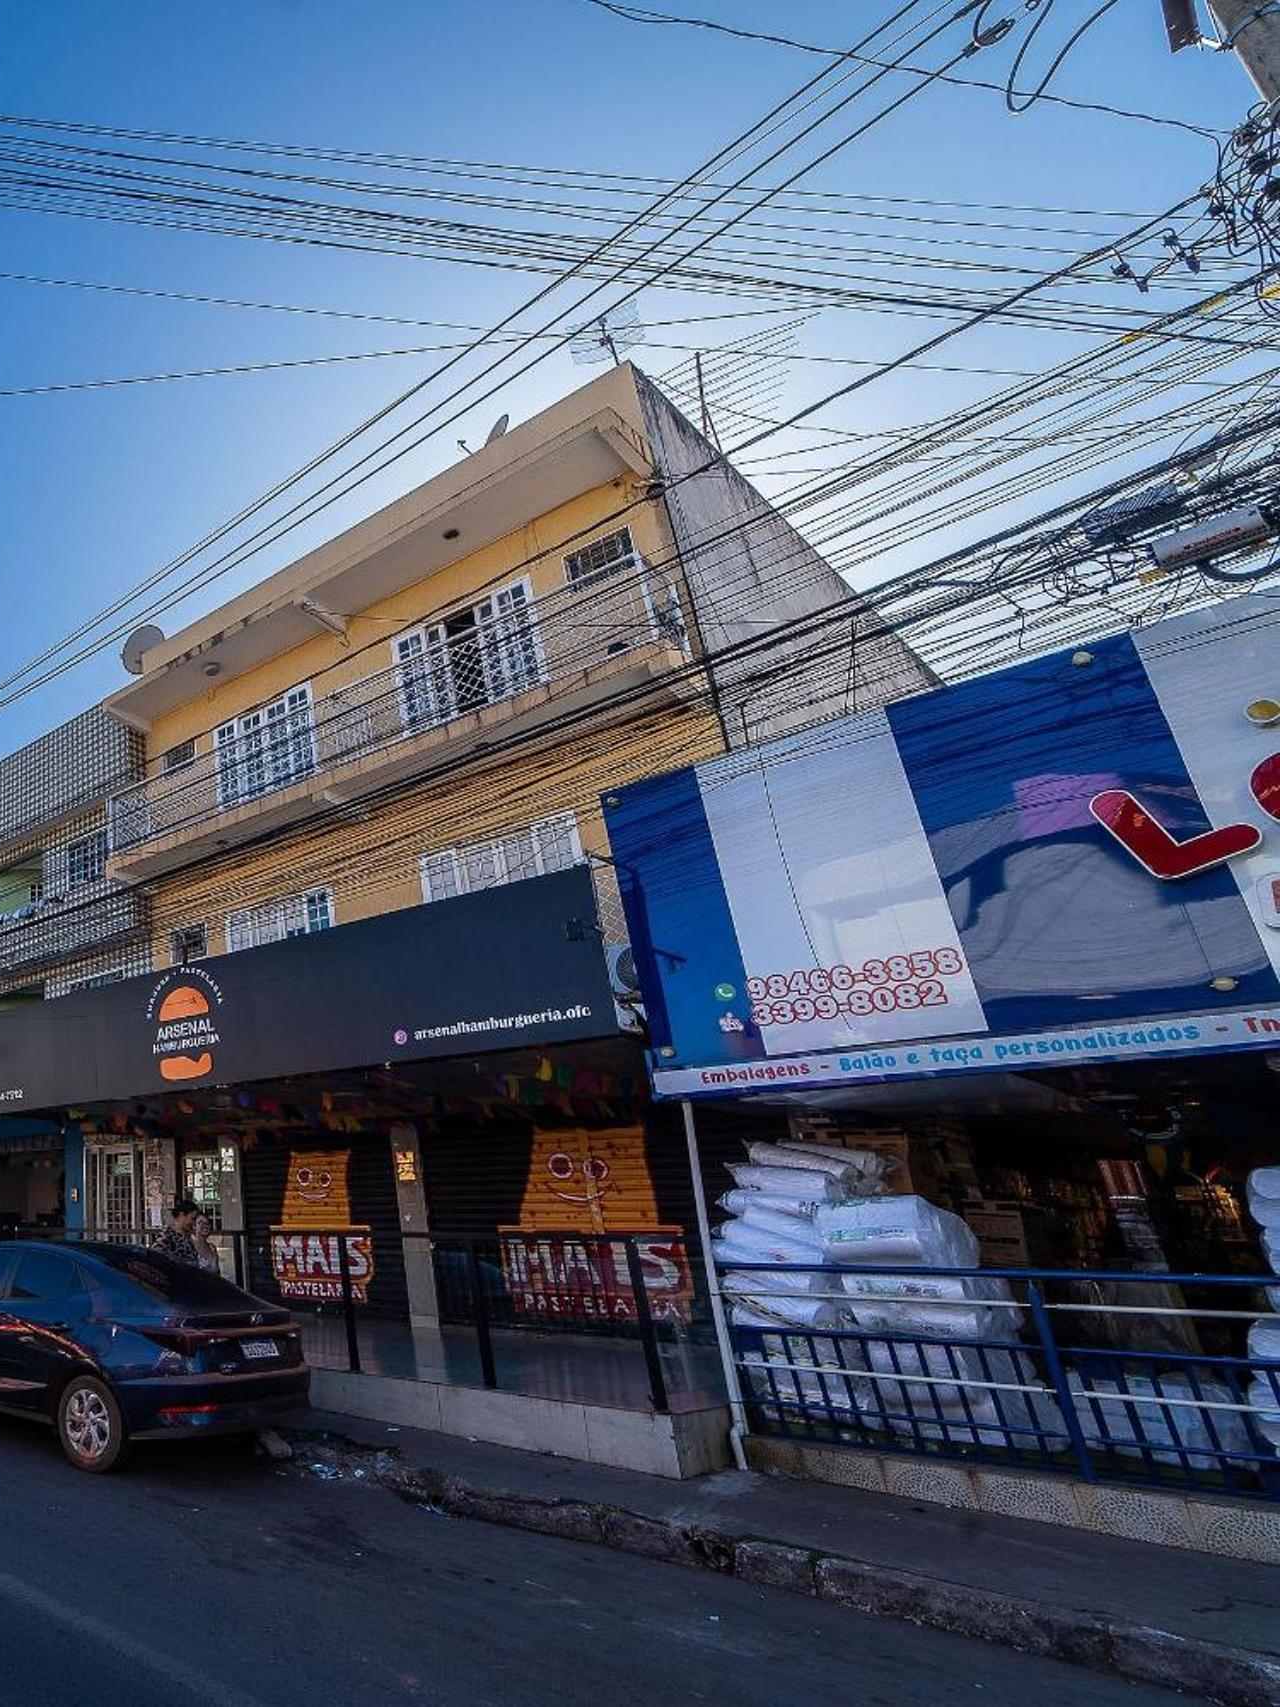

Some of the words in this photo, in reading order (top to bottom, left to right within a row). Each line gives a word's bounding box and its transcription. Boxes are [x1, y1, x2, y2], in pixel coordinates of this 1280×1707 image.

[746, 947, 964, 1001] 98466-3858
[413, 1004, 592, 1042] arsenalhamburgueria.ofc
[751, 979, 949, 1026] 3399-8082
[156, 1018, 216, 1042] ARSENAL
[701, 1060, 811, 1086] Embalagens
[839, 1050, 897, 1073] Balão
[907, 1049, 920, 1065] e
[929, 1045, 984, 1065] taça
[995, 1023, 1201, 1060] personalizados
[274, 1234, 369, 1277] MAIS
[507, 1239, 682, 1289] MAIS
[282, 1280, 363, 1299] PASTELARA
